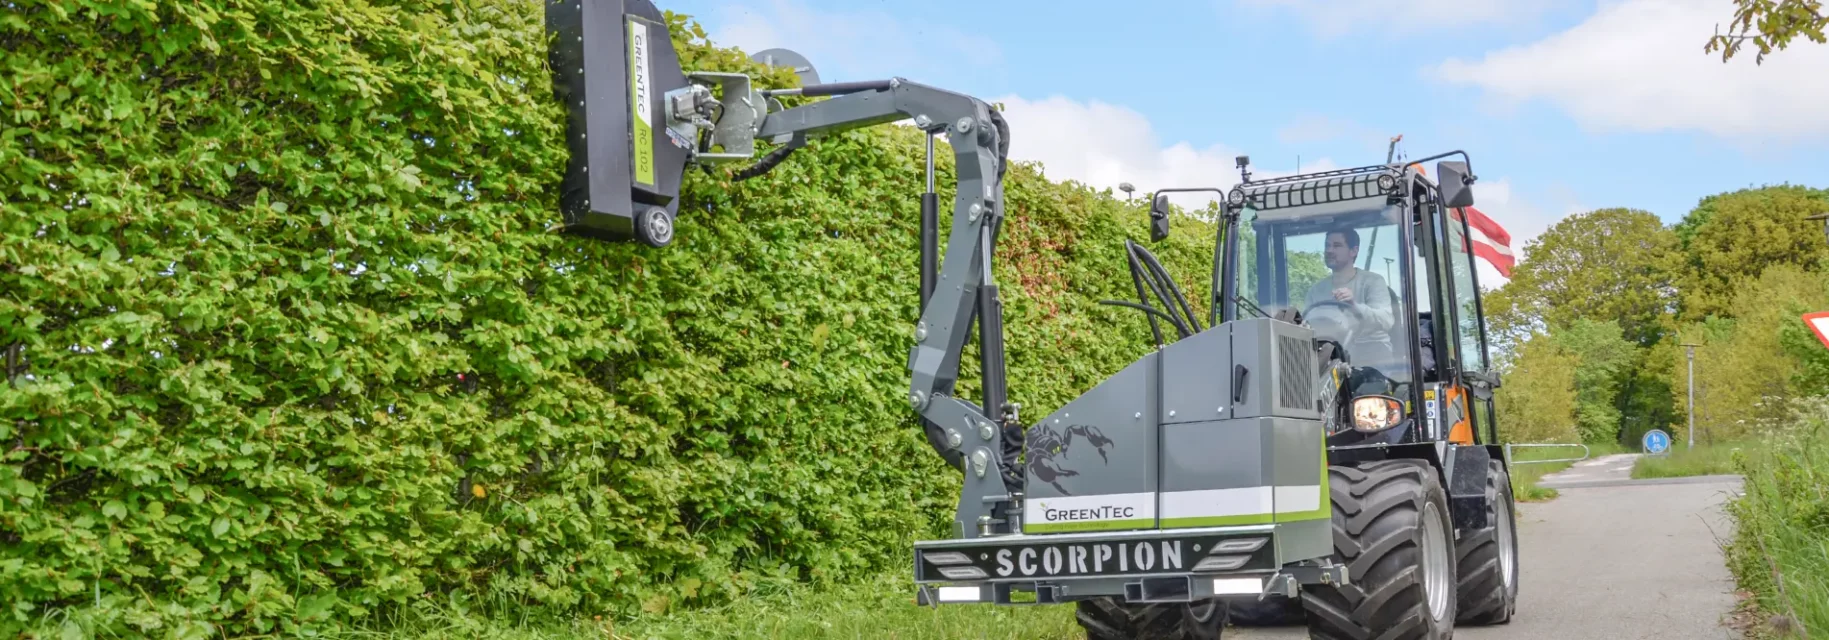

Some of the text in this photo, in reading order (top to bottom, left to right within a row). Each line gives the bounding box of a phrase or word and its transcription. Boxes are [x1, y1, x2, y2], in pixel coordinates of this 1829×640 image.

[639, 127, 649, 173] RC 102
[1045, 505, 1134, 521] GREENTEC
[996, 540, 1182, 577] SCORPION
